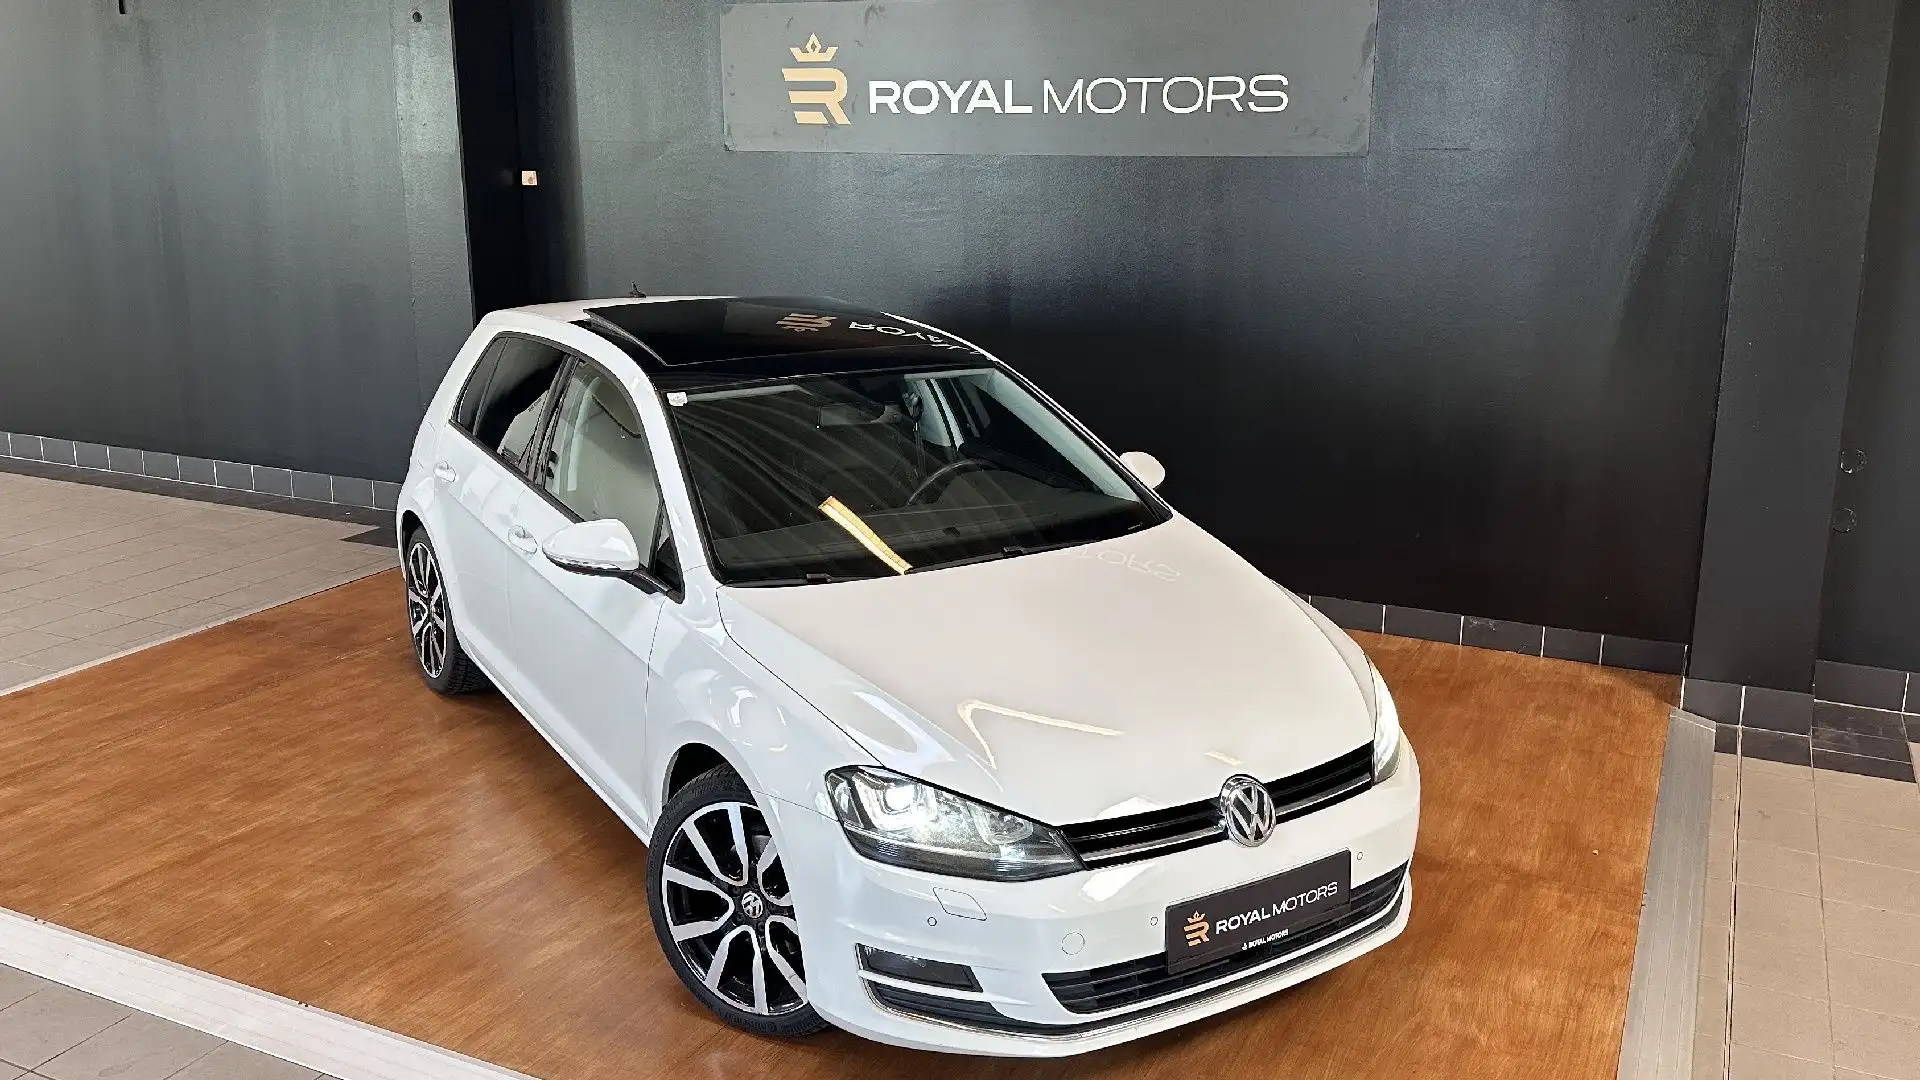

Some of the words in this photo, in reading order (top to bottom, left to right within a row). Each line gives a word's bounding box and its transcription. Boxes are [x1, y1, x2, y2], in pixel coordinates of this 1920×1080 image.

[868, 79, 1032, 115] ROYAL
[1043, 74, 1289, 114] MOTORS
[1215, 908, 1270, 935] ROYAL
[1272, 881, 1338, 915] MOTORS
